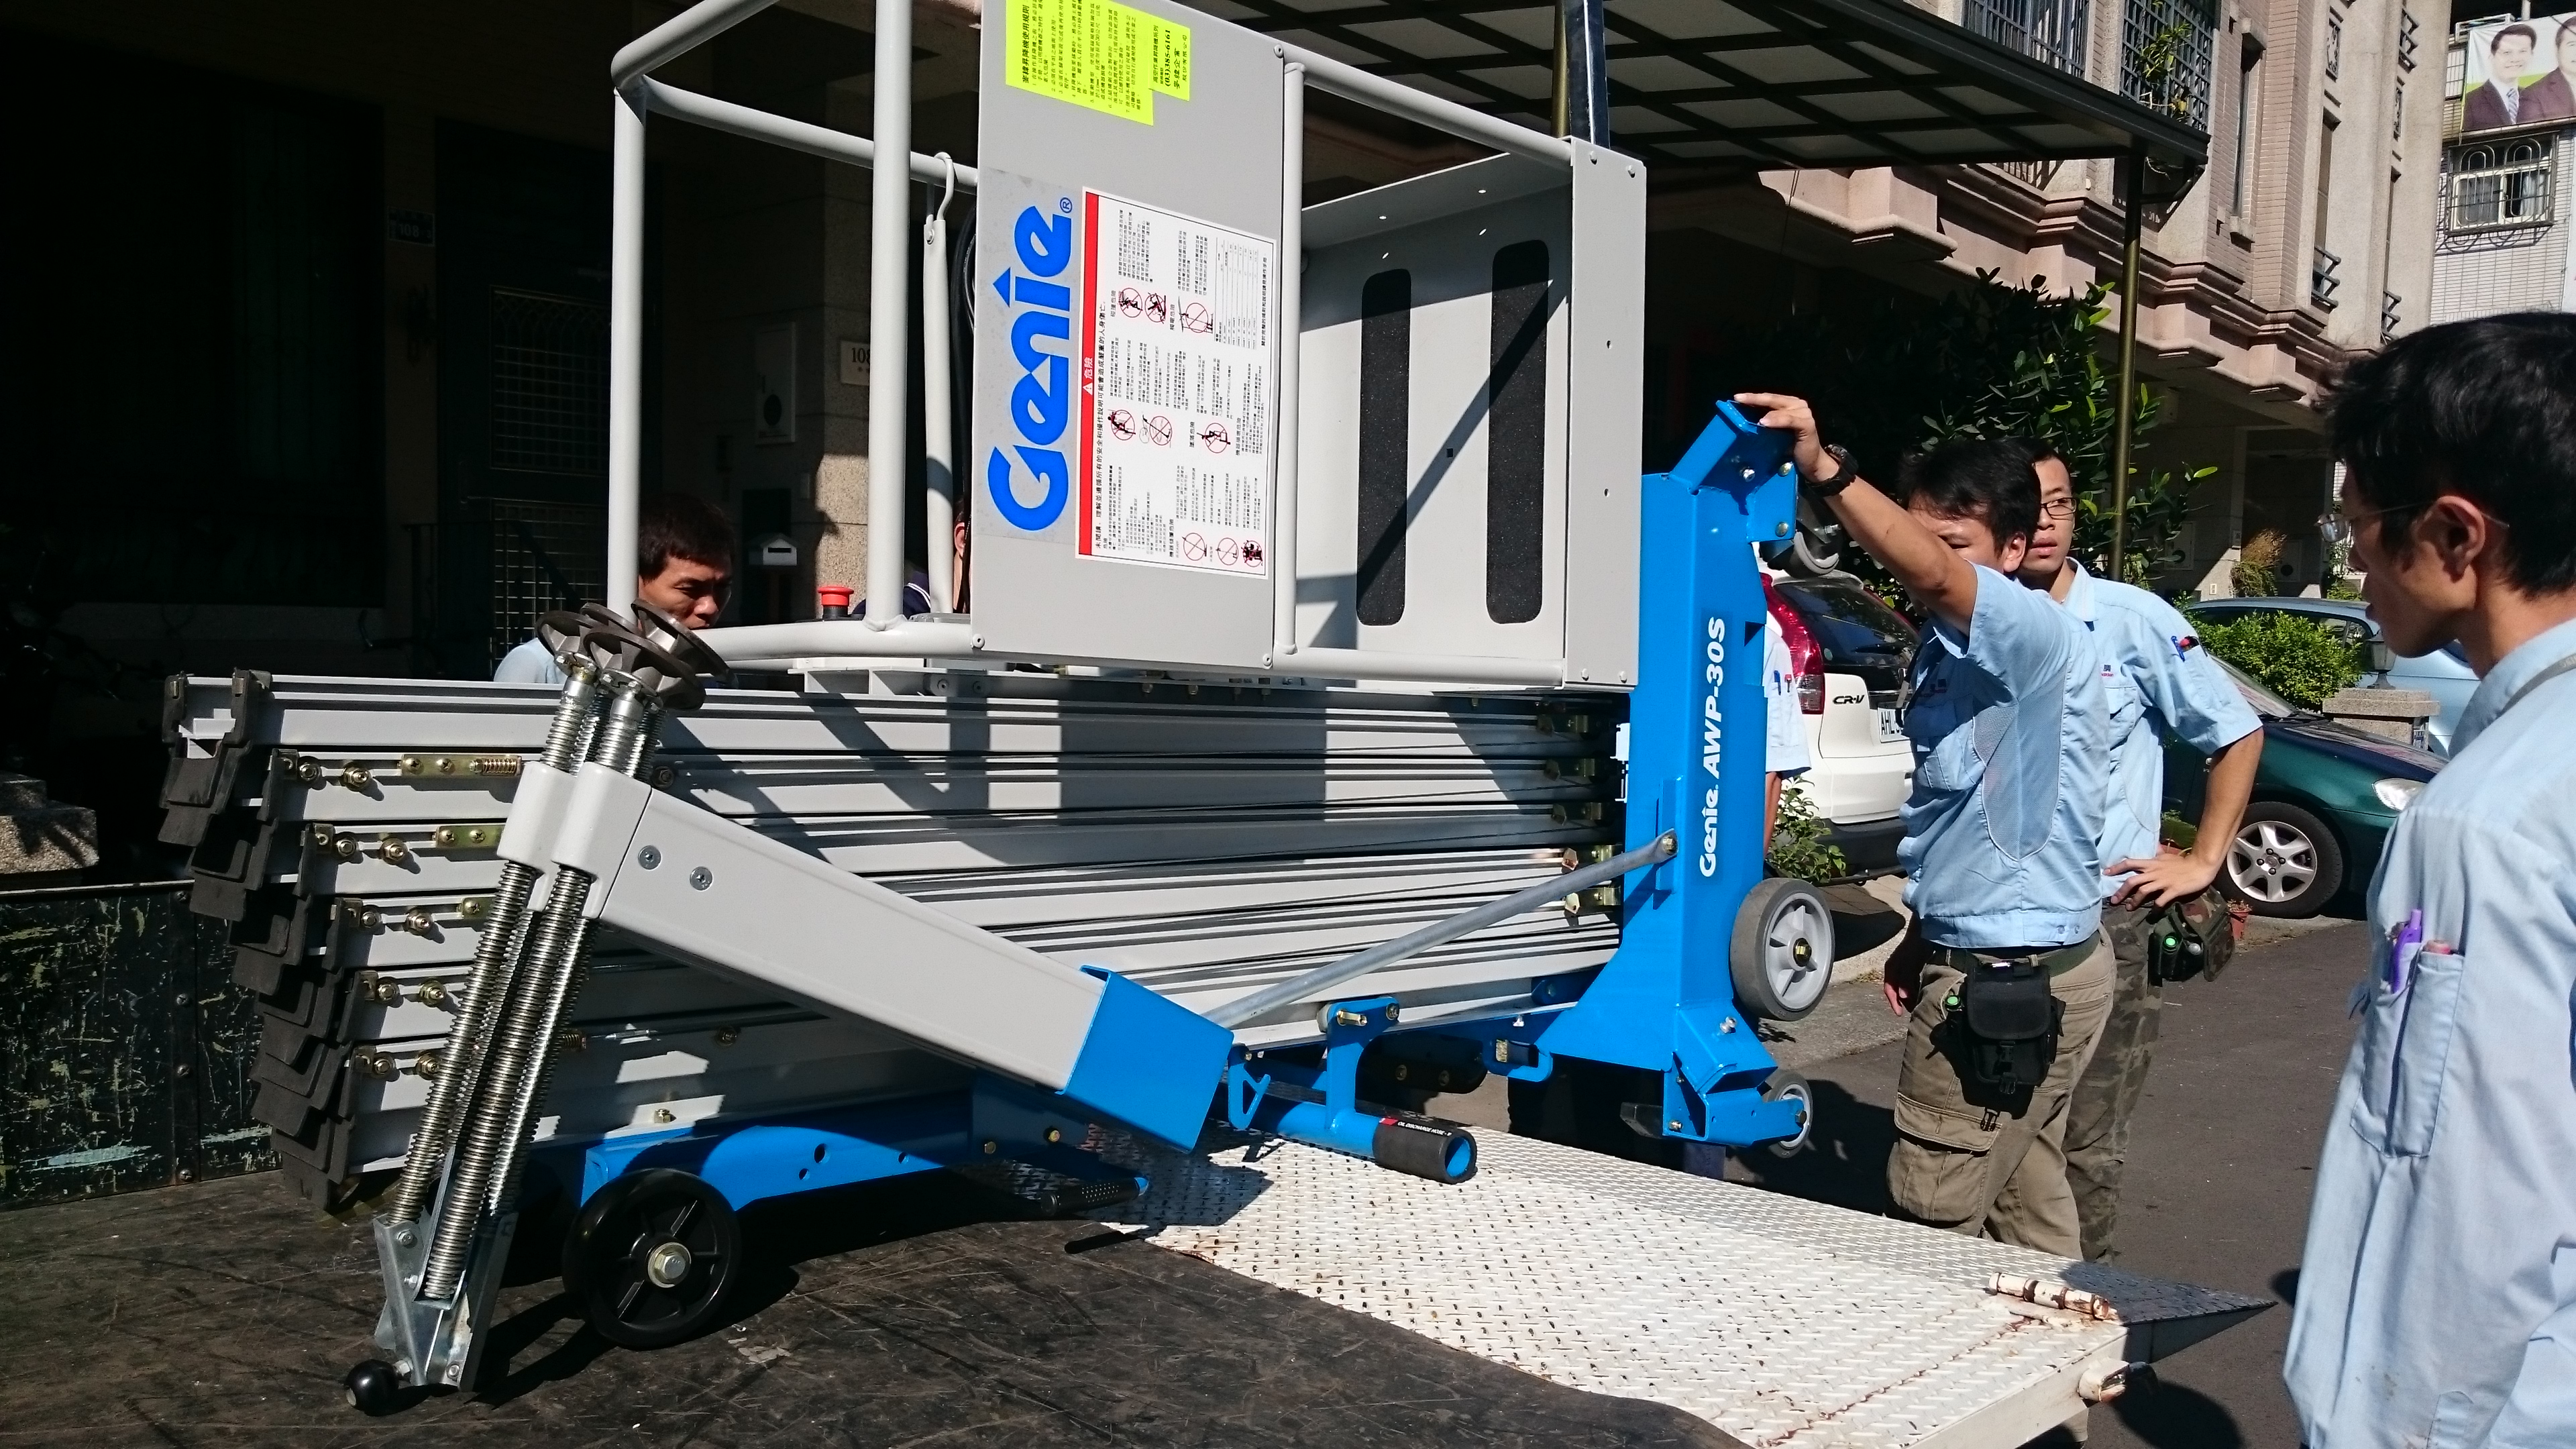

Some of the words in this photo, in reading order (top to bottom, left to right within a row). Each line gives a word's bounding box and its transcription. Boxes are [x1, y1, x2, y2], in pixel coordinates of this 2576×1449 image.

[987, 205, 1071, 530] Genie
[1084, 357, 1093, 380] 危險
[1703, 616, 1725, 780] AWP-30S
[1699, 789, 1718, 877] Genie
[1405, 1123, 1432, 1132] DISCHARGE
